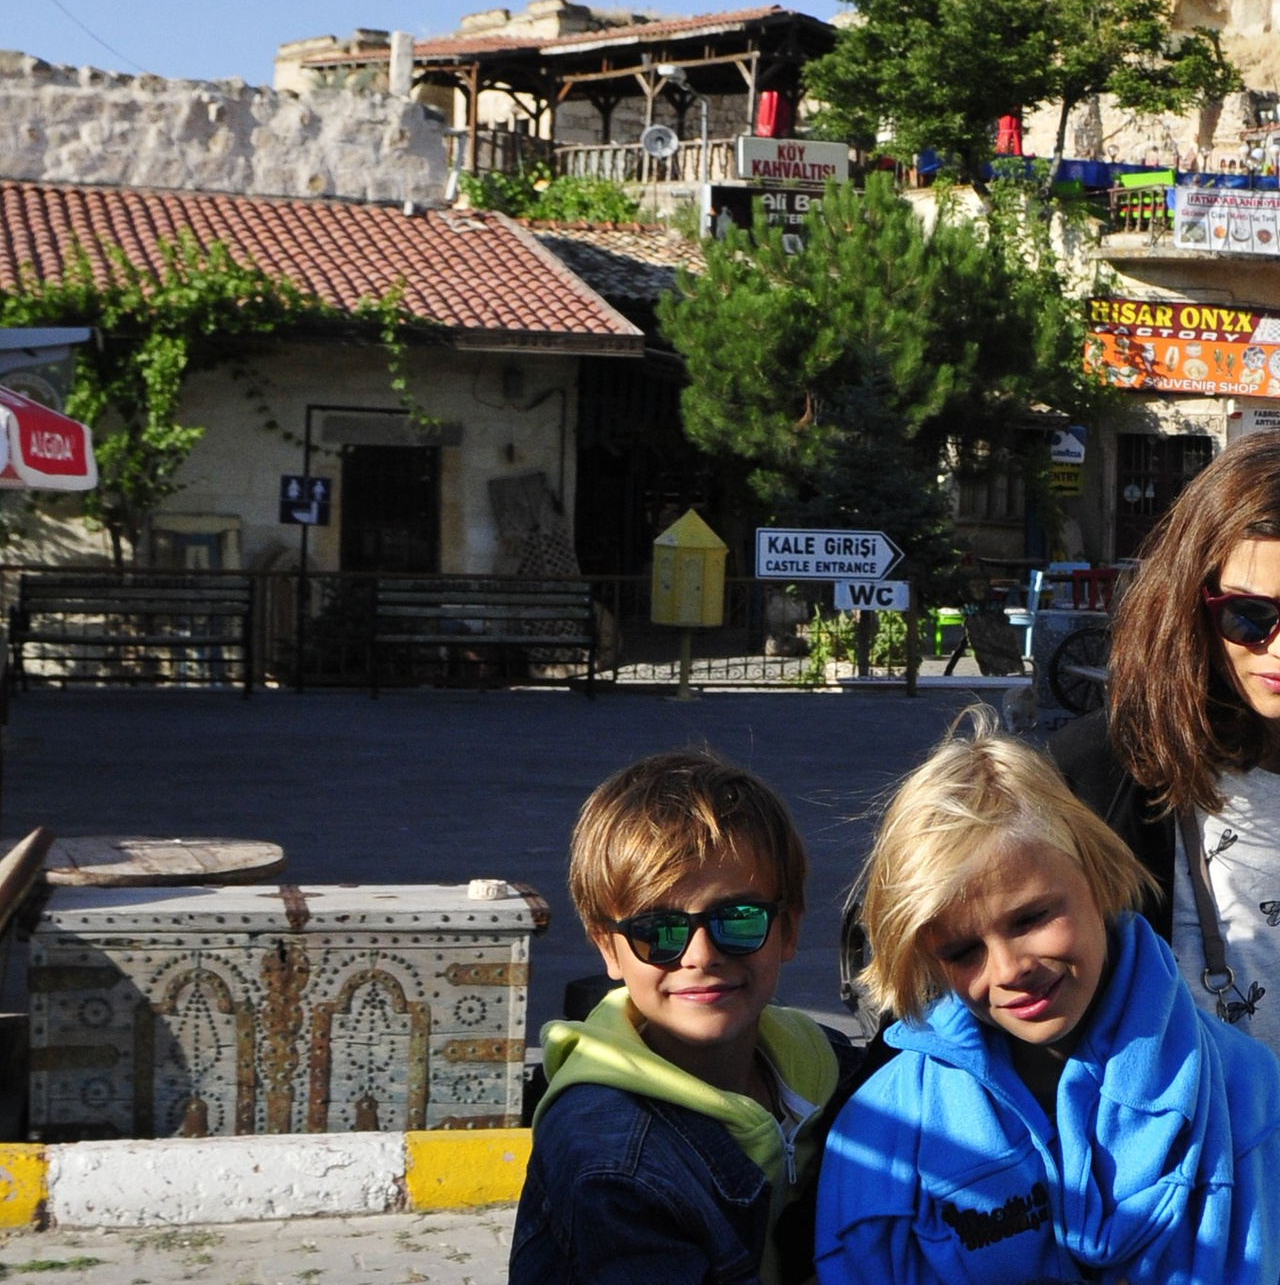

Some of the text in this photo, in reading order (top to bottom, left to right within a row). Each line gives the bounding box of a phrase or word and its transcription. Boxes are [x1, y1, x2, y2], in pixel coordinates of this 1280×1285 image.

[777, 142, 806, 160] KÖY
[761, 193, 787, 211] Ali
[1180, 307, 1254, 333] ONYX
[1094, 325, 1242, 343] FACTORY
[1144, 376, 1259, 394] SOUVENIR SHOP
[768, 536, 815, 555] KALE
[765, 560, 876, 574] CASTLE ENTRANCE
[849, 584, 894, 606] WC
